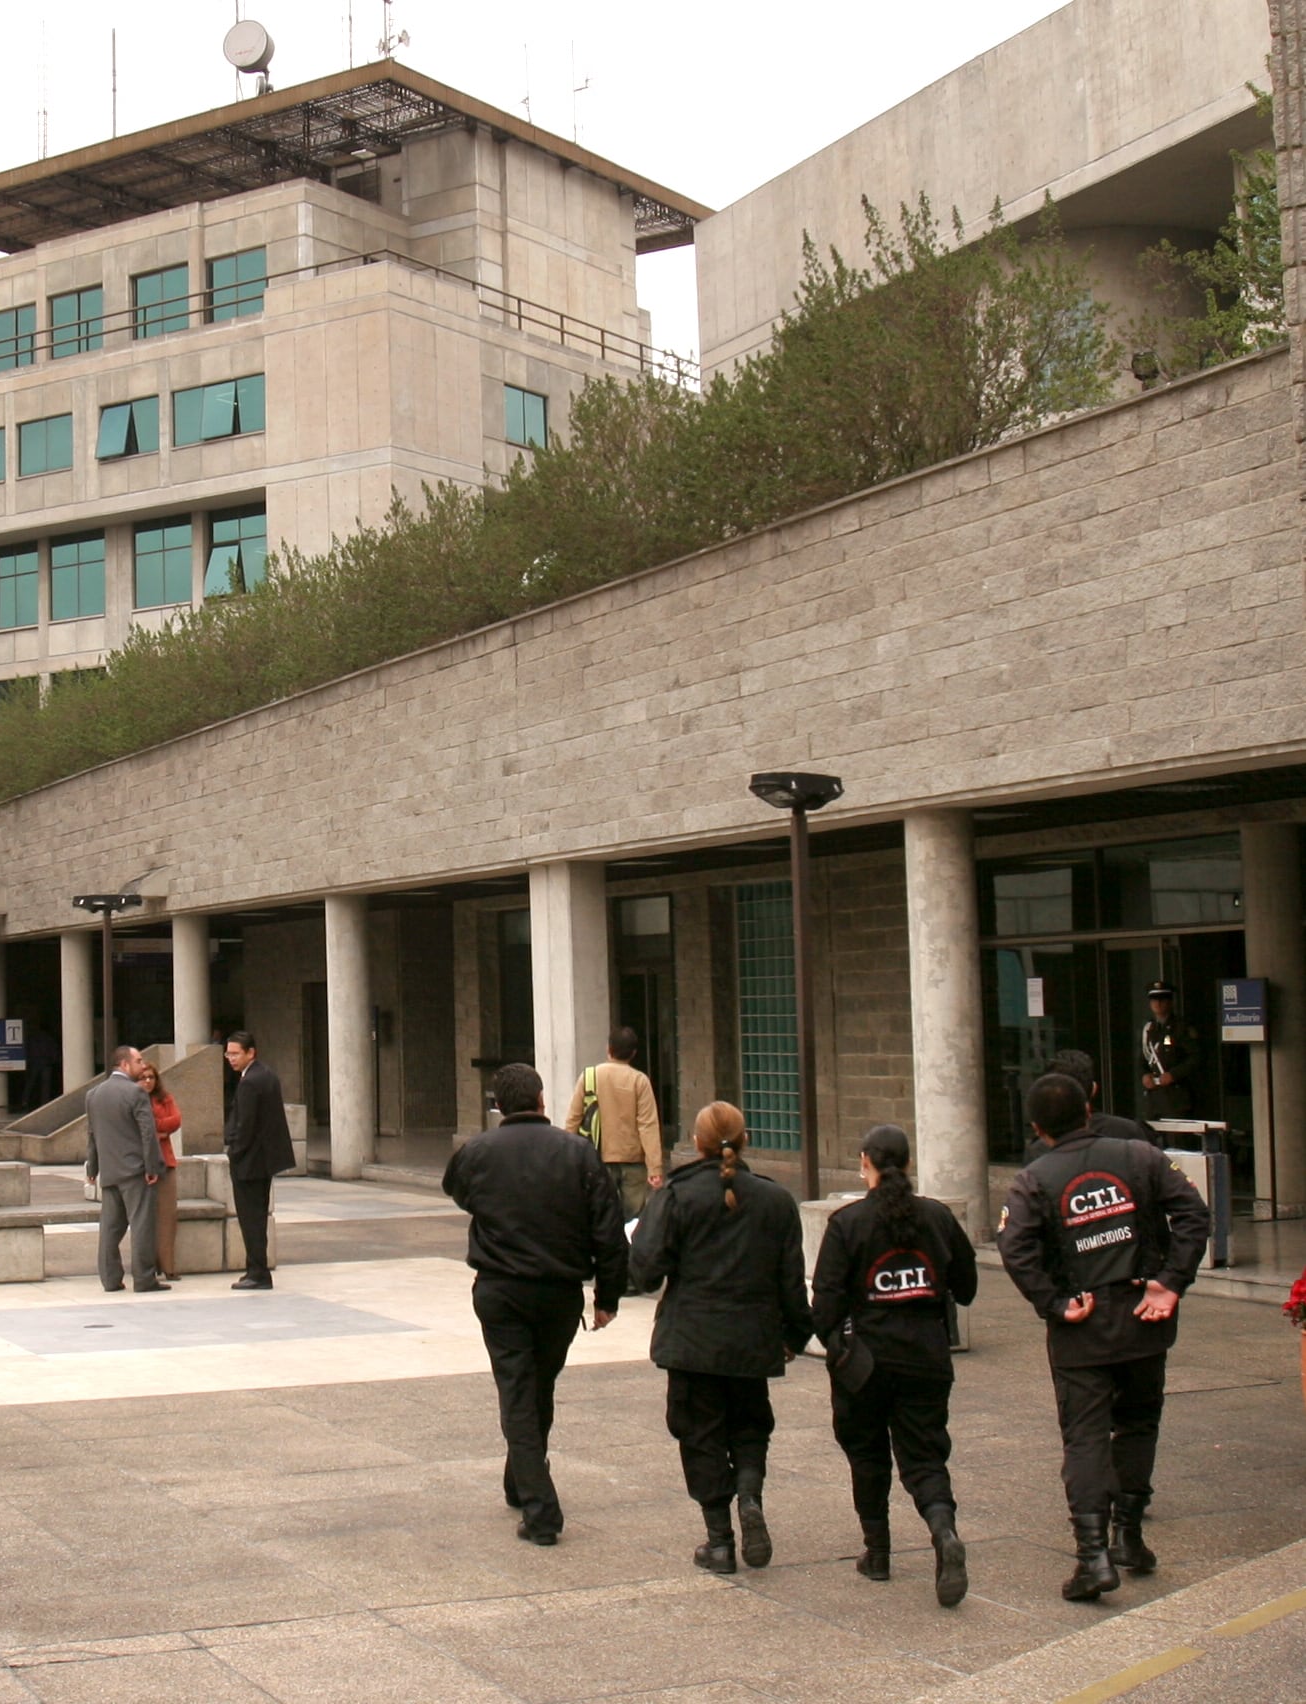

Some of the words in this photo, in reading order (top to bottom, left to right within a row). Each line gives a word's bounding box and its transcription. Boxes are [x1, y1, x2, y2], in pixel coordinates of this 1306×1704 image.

[1225, 1012, 1260, 1023] Auditorio
[7, 1025, 21, 1041] T
[1070, 1186, 1126, 1215] C.T.I.
[1076, 1226, 1132, 1252] HOMICIDIOS
[875, 1267, 931, 1291] C.T.I.
